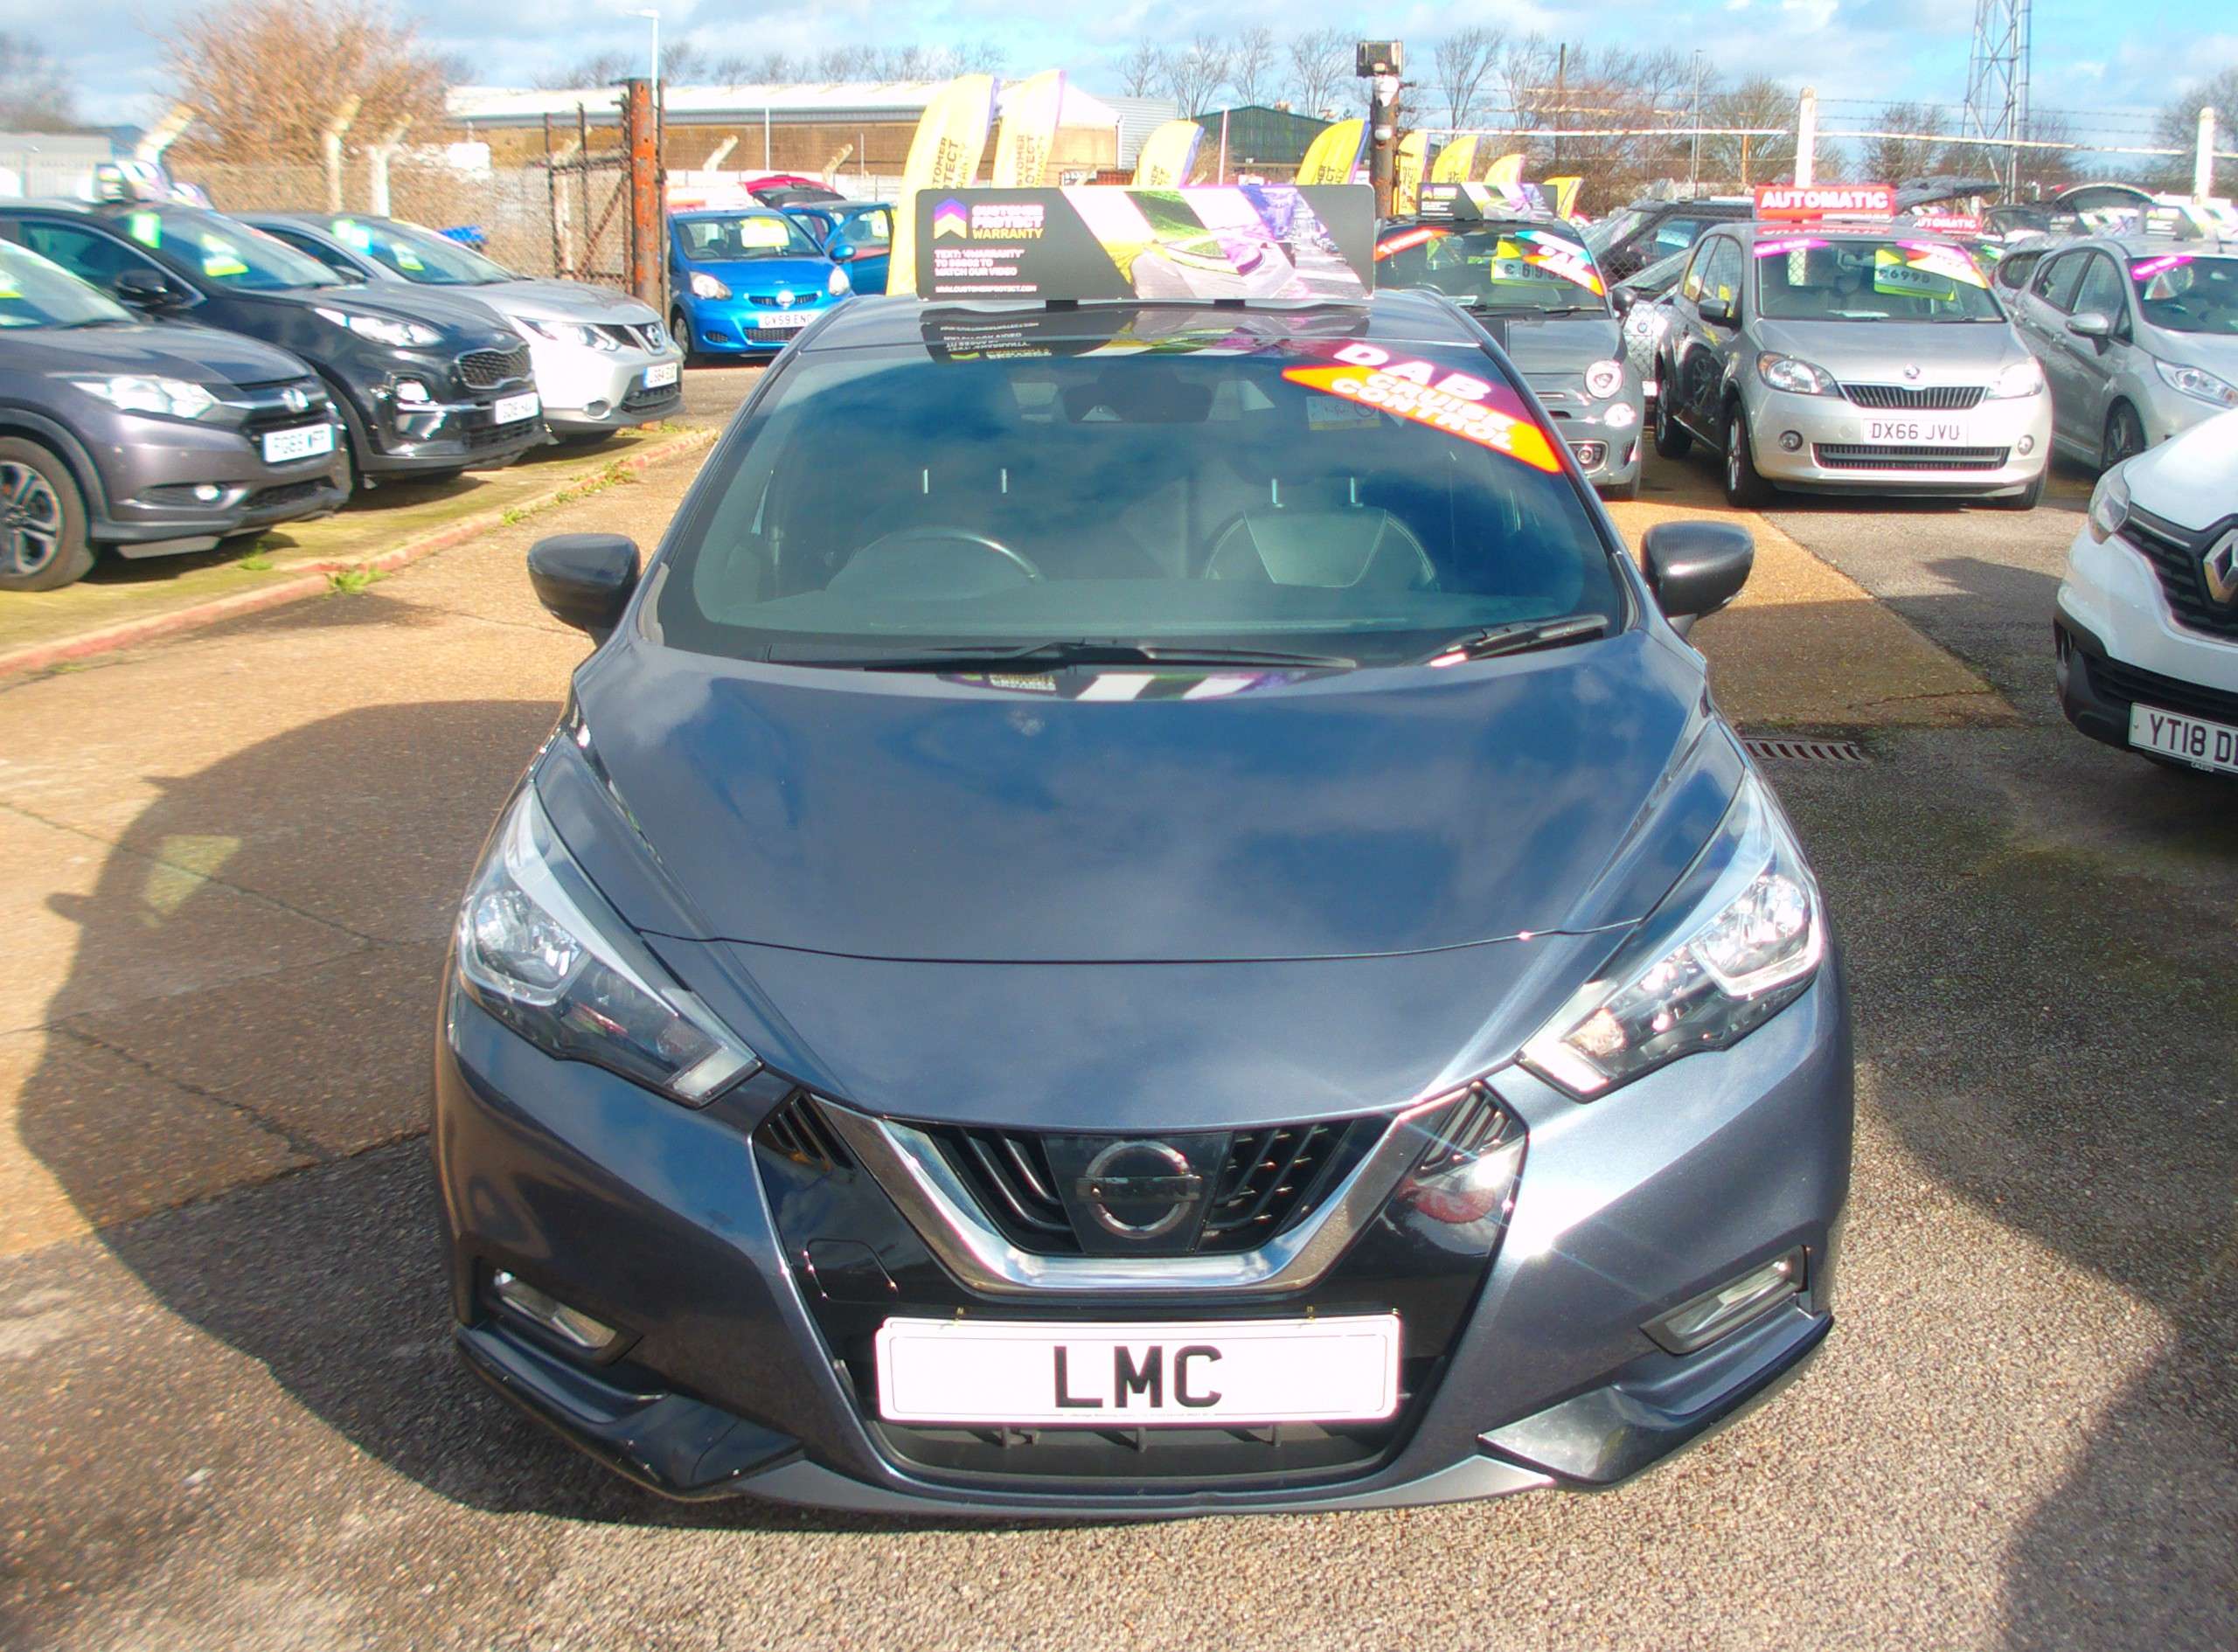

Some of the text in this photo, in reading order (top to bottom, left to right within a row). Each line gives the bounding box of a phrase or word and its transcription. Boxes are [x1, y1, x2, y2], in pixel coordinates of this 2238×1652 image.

[1761, 191, 1888, 209] AUTOMATIC
[972, 227, 1044, 239] WARRANTY
[1333, 343, 1492, 400] DAB
[1331, 378, 1513, 451] CONTROL
[1366, 372, 1516, 433] CRUISE
[1871, 422, 1960, 441] DX66 JVU
[2150, 712, 2238, 767] YT18 D
[1053, 1345, 1222, 1409] LMC
